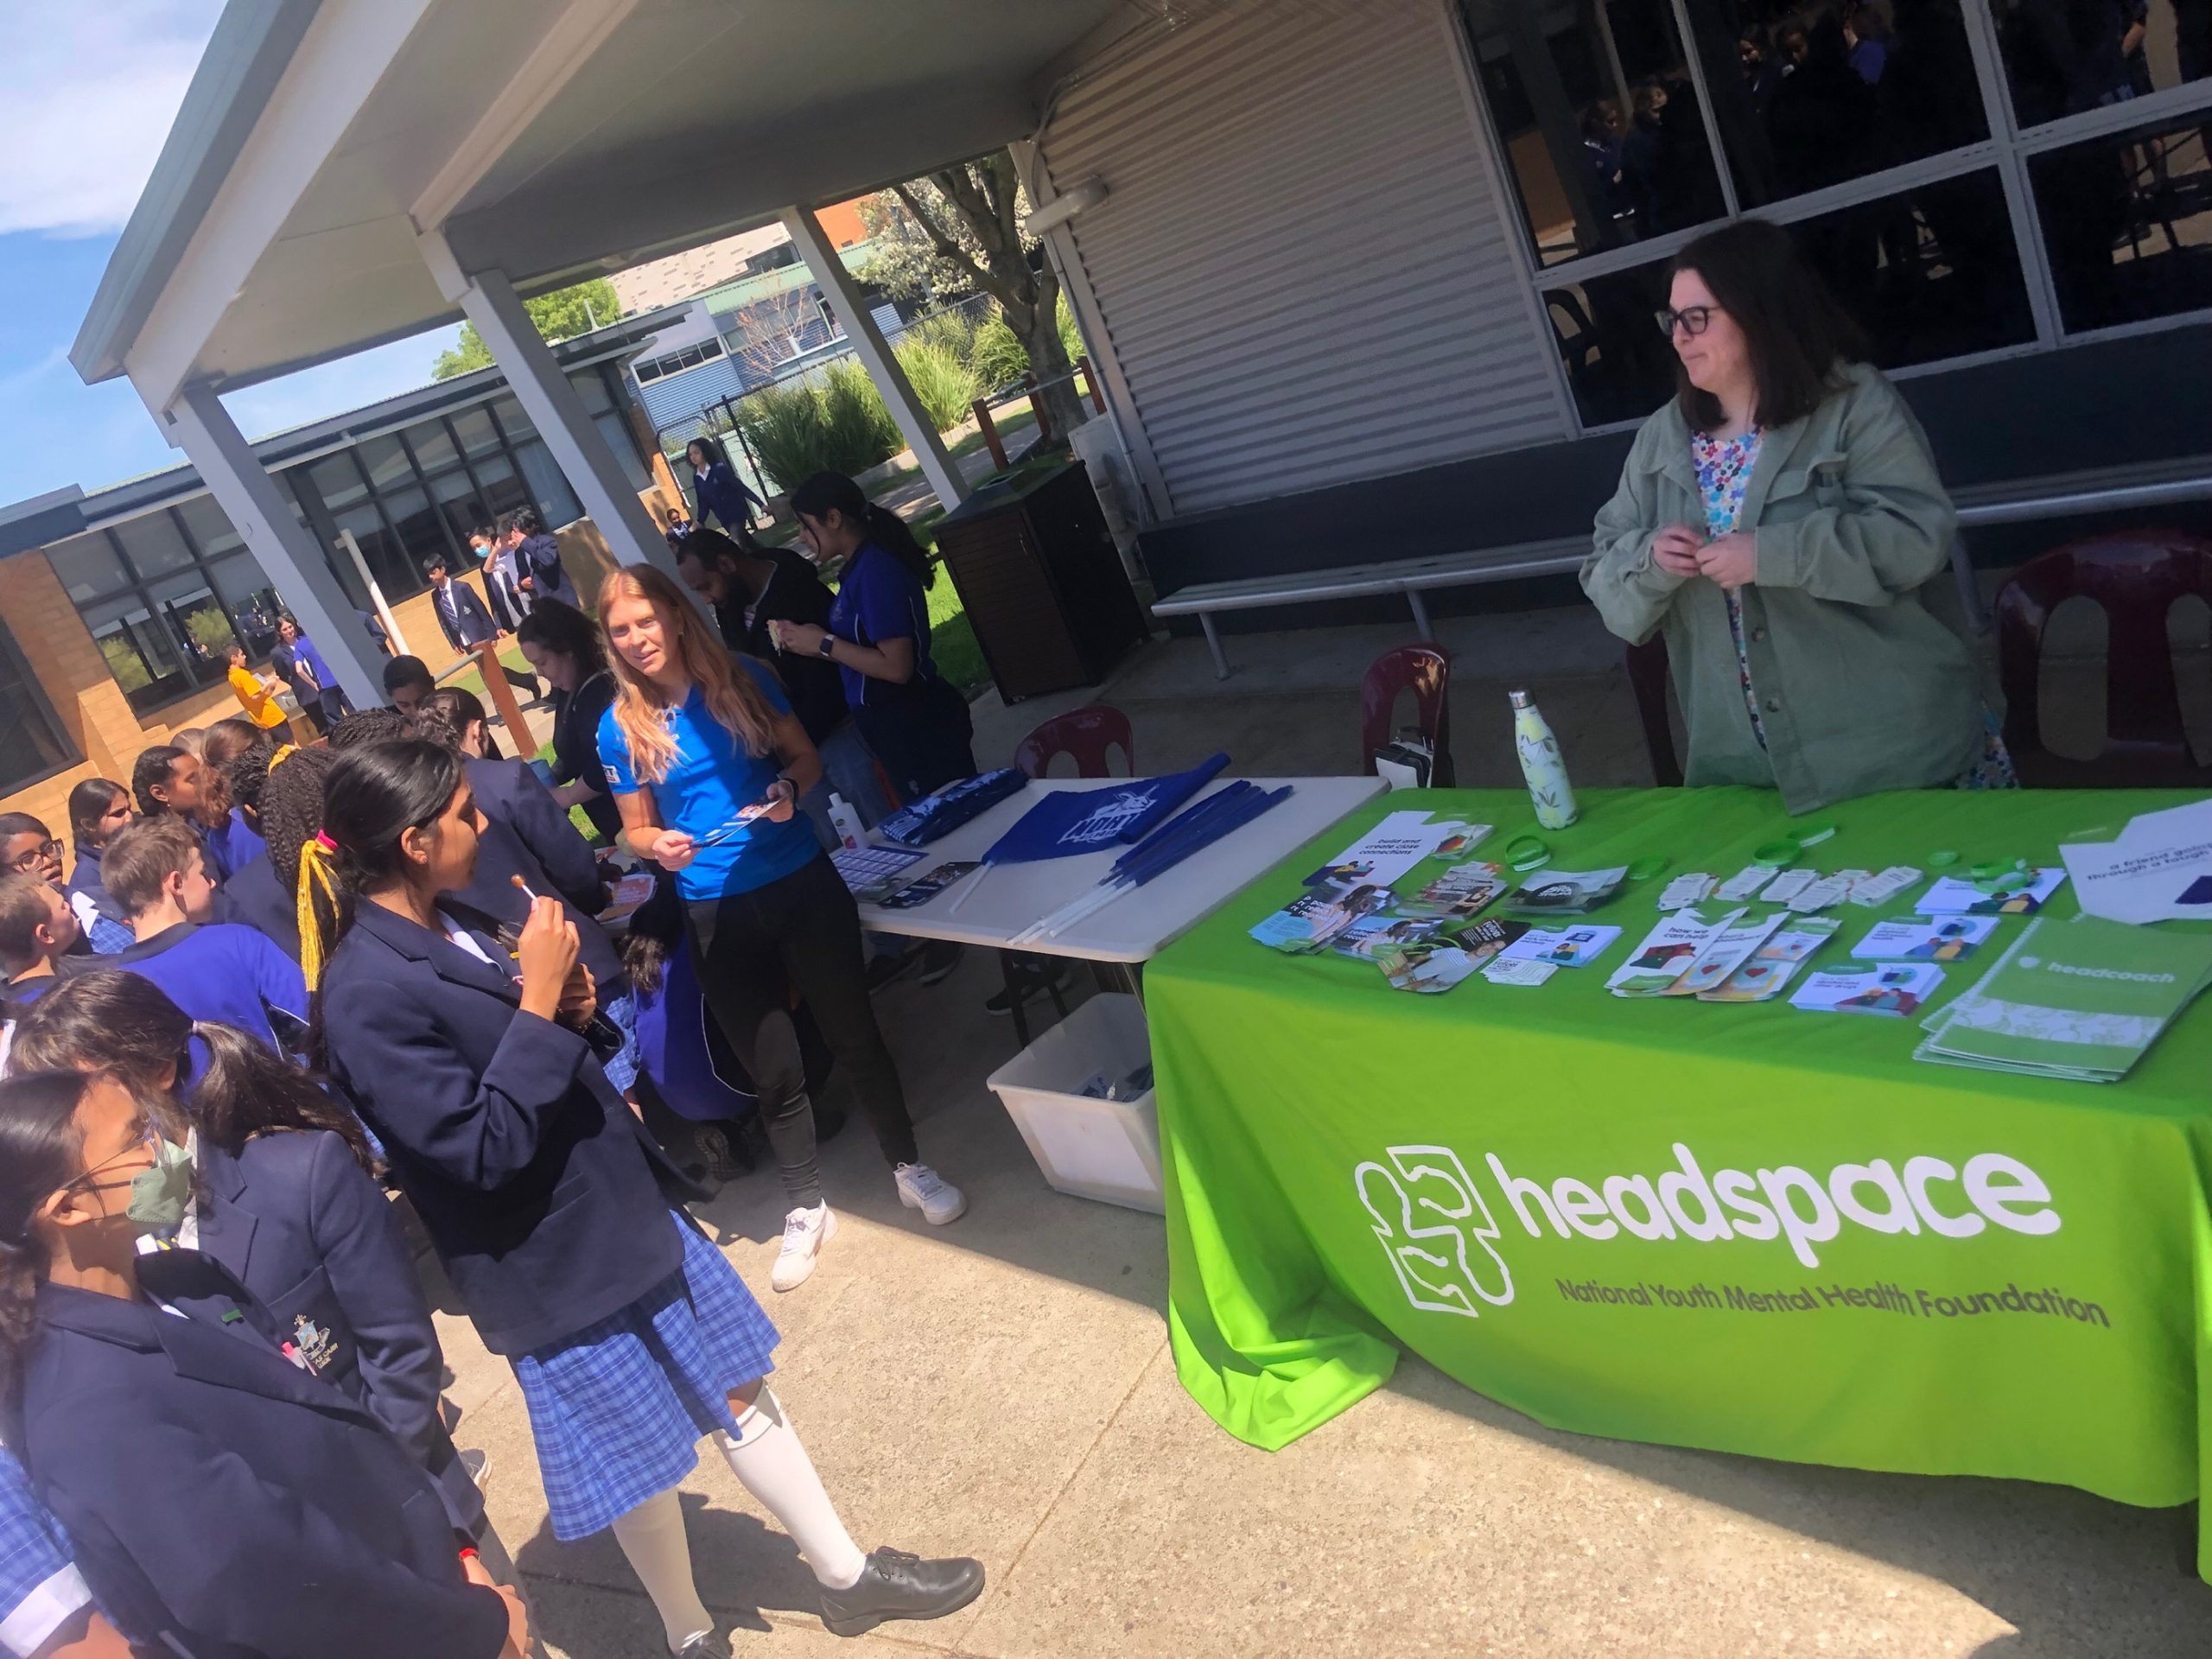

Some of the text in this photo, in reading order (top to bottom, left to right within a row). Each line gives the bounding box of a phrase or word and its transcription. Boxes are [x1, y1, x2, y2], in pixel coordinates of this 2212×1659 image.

[2123, 852, 2169, 867] friend
[2047, 962, 2176, 983] headcoach
[1484, 1142, 2062, 1268] headspace
[1555, 1278, 2110, 1328] National Youth Mental Health Foundation
